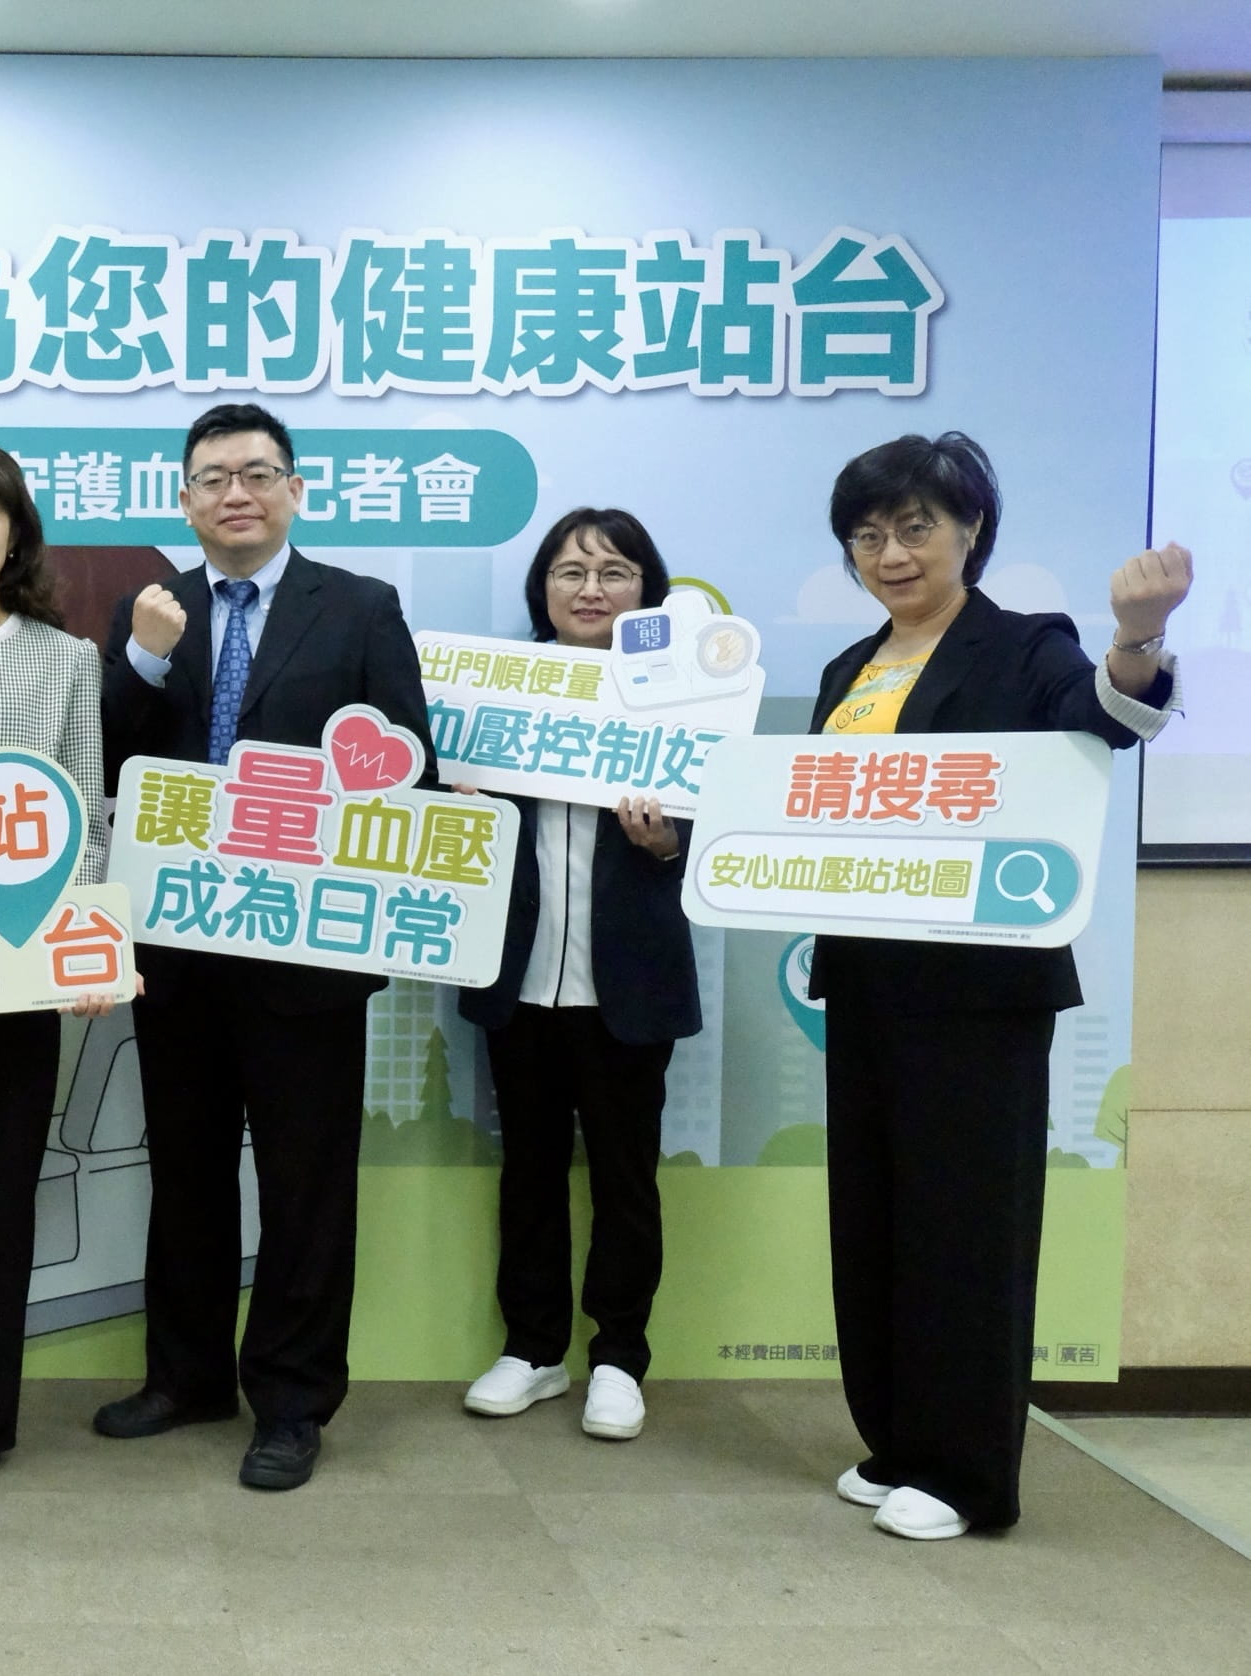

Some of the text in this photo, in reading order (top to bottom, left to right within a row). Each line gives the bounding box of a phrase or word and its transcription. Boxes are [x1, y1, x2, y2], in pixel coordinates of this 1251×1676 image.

[421, 646, 605, 701] 出門順便量
[427, 698, 726, 795] 血壓控制好
[135, 751, 497, 886] 讓量血壓
[786, 751, 1001, 822] 請搜尋
[146, 859, 462, 966] 成為日常
[708, 852, 973, 899] 安心血壓站地圖
[44, 908, 123, 988] 台
[1061, 1346, 1095, 1363] 廣告
